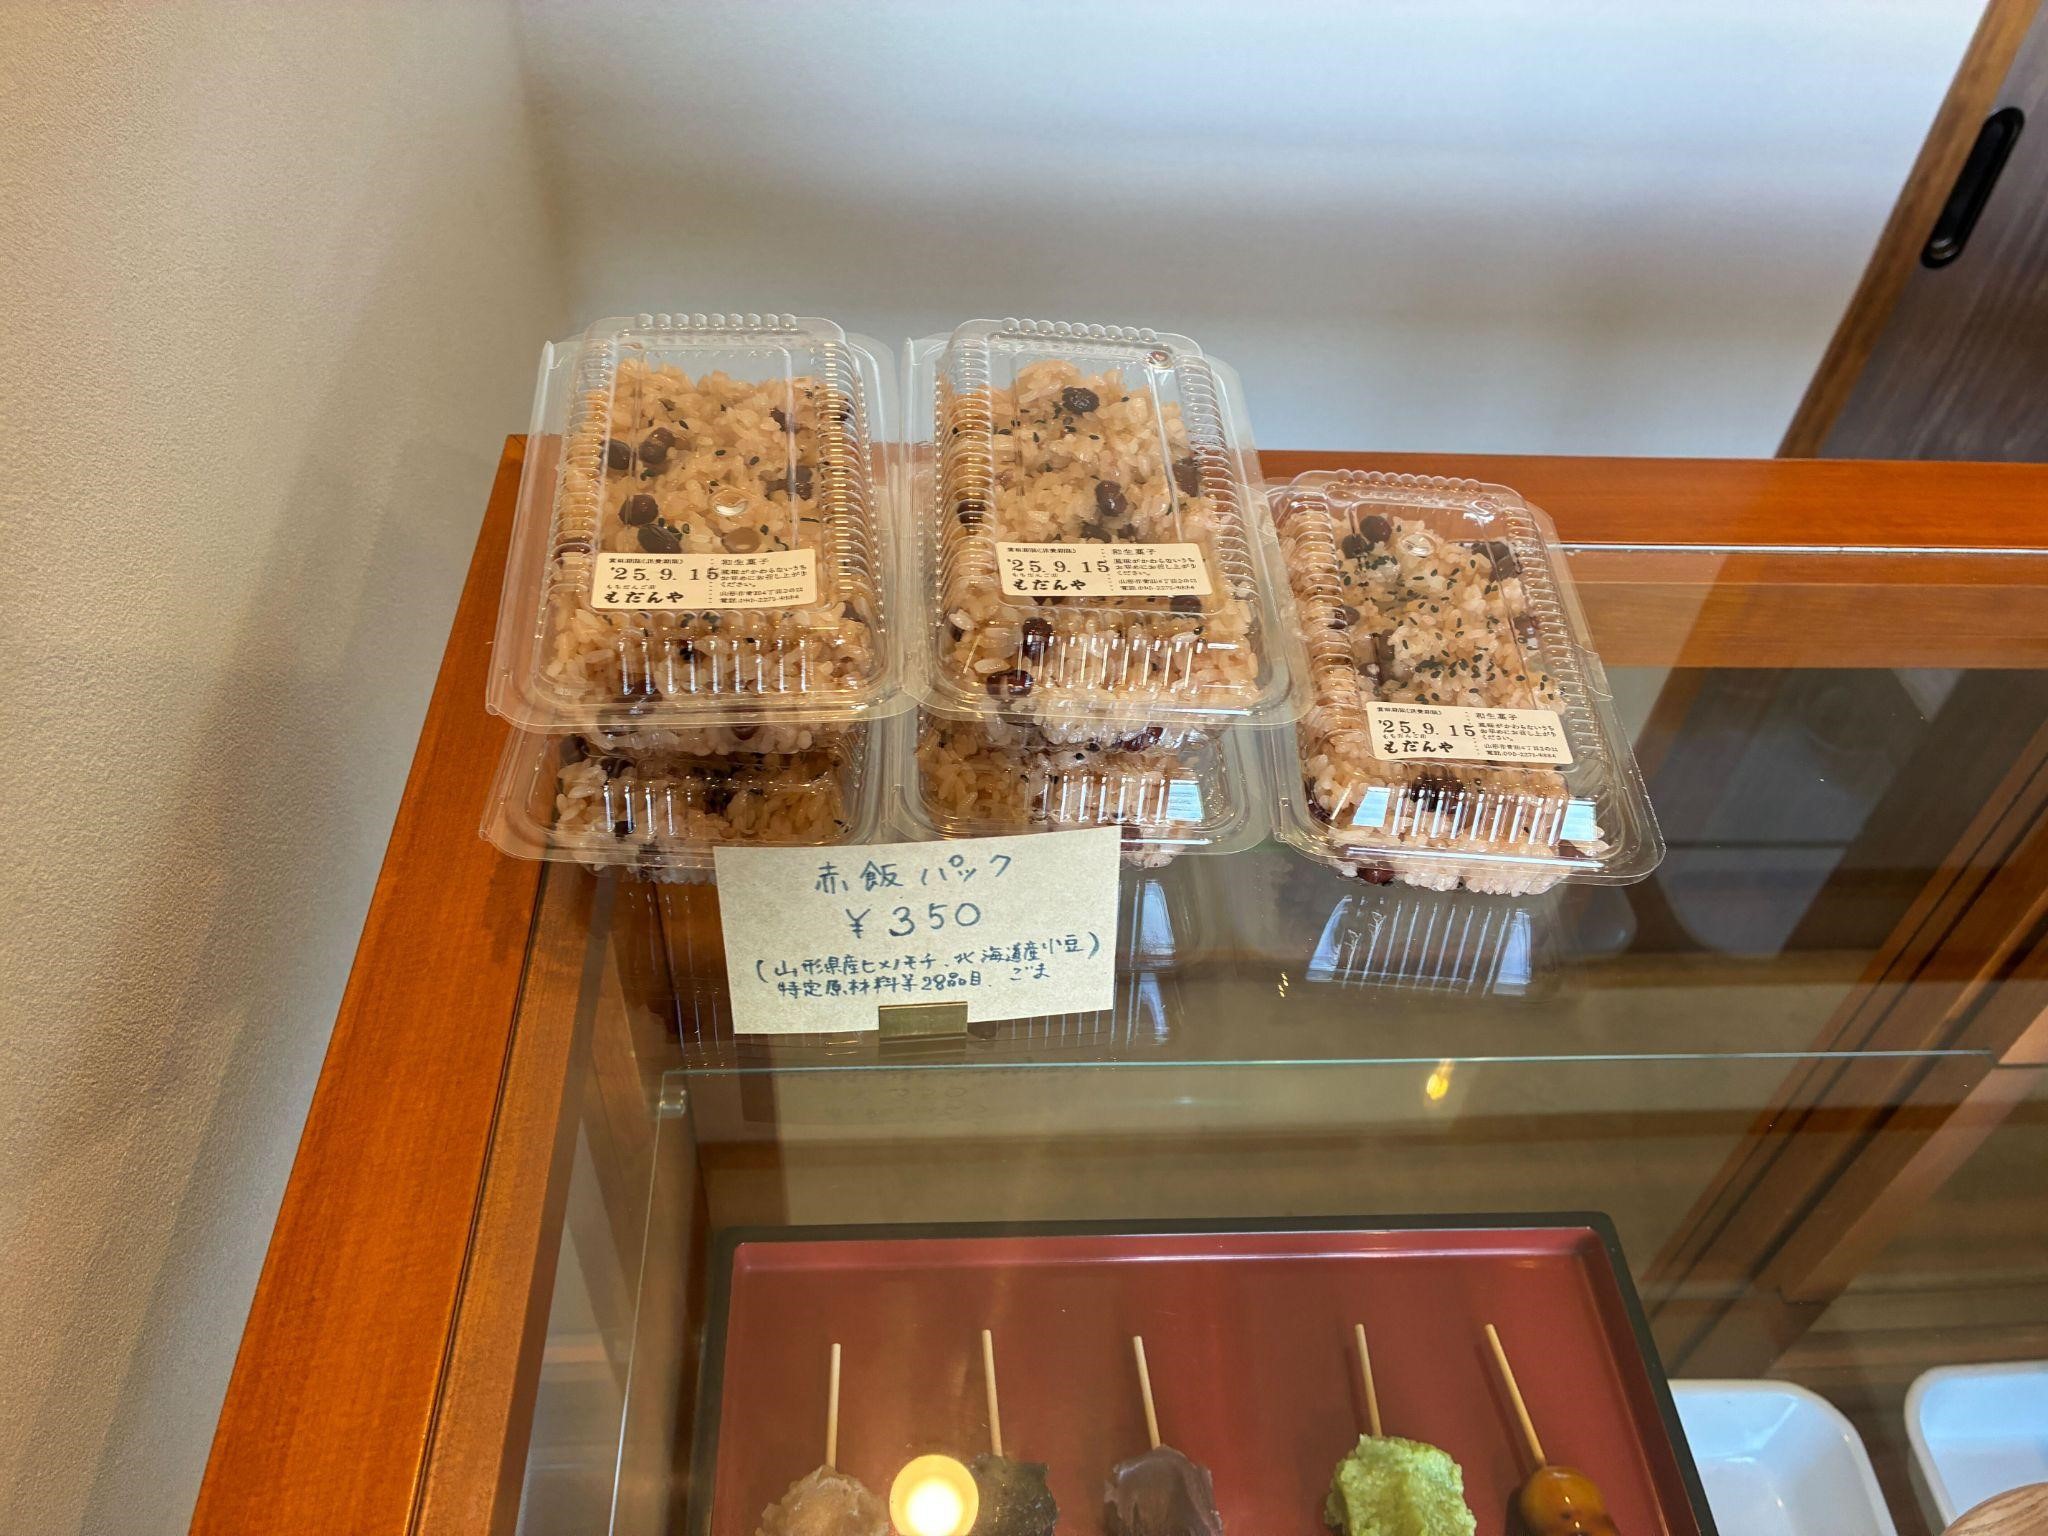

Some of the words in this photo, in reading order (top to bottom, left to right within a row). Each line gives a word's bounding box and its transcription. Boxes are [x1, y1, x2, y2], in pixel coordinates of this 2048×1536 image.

[1112, 548, 1157, 556] 和生菓子
[721, 557, 769, 566] 和生菓子
[1013, 579, 1087, 591] もだんや
[604, 591, 685, 604] もだんや
[1476, 712, 1518, 721] 和生菓子
[1384, 741, 1454, 754] もだんや
[815, 854, 1012, 895] 赤飯パック
[845, 902, 981, 939] ¥350
